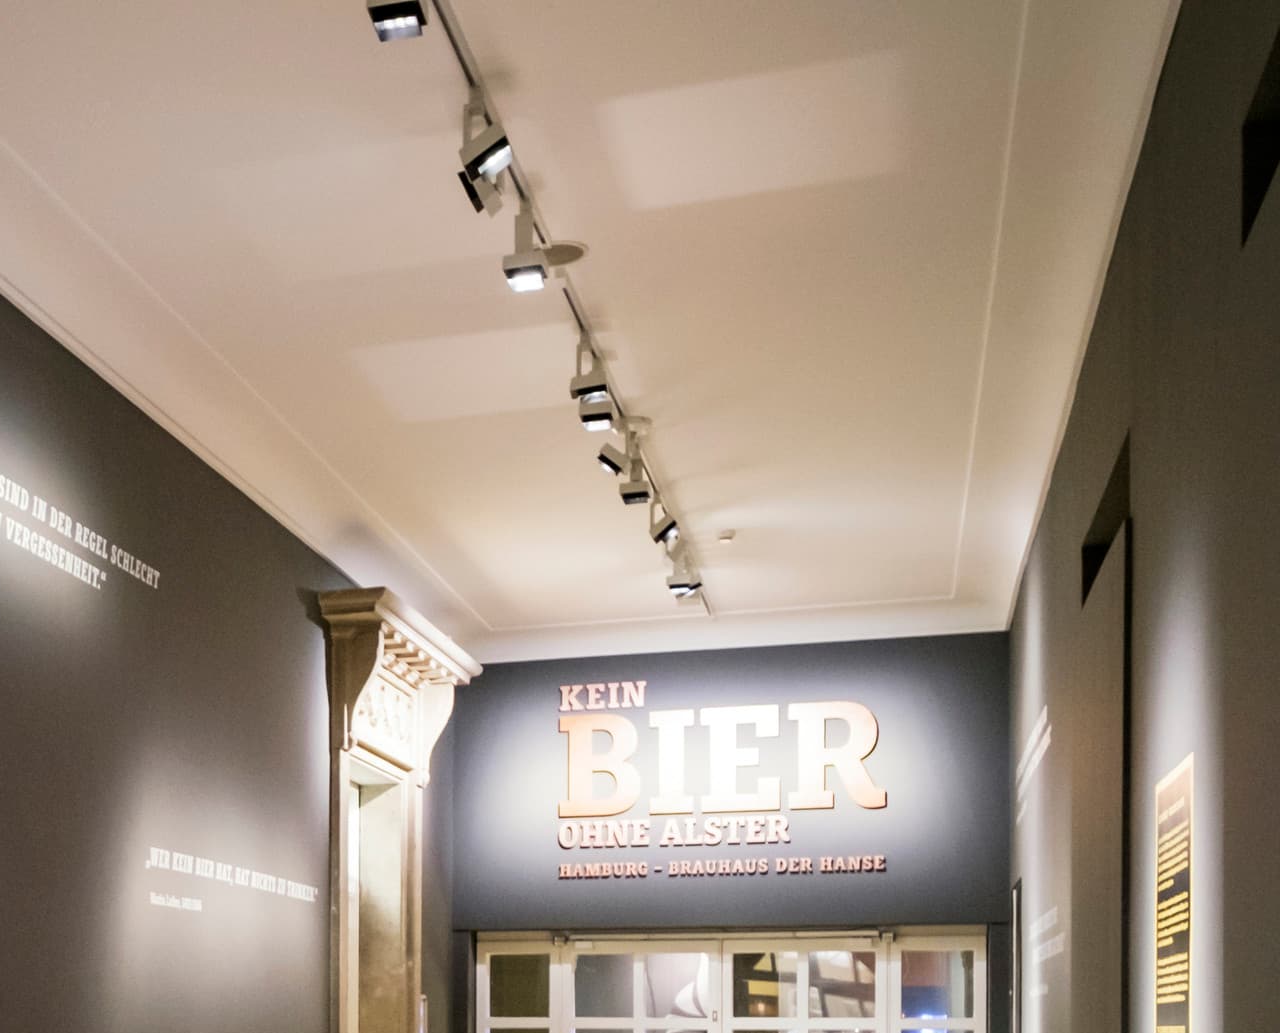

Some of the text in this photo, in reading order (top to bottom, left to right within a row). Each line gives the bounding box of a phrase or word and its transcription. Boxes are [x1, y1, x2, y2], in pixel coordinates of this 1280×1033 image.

[32, 495, 47, 520] IN
[50, 506, 72, 539] DER
[75, 523, 108, 560] REGEL
[111, 543, 160, 589] SCHLECHT
[559, 681, 647, 712] KEIN
[558, 700, 887, 818] BIER
[558, 817, 791, 849] OHNE ALSTER
[558, 862, 649, 880] HAMBURG
[668, 857, 769, 877] BRAUHAUS
[775, 857, 813, 875] DER
[820, 855, 886, 873] HANSE
